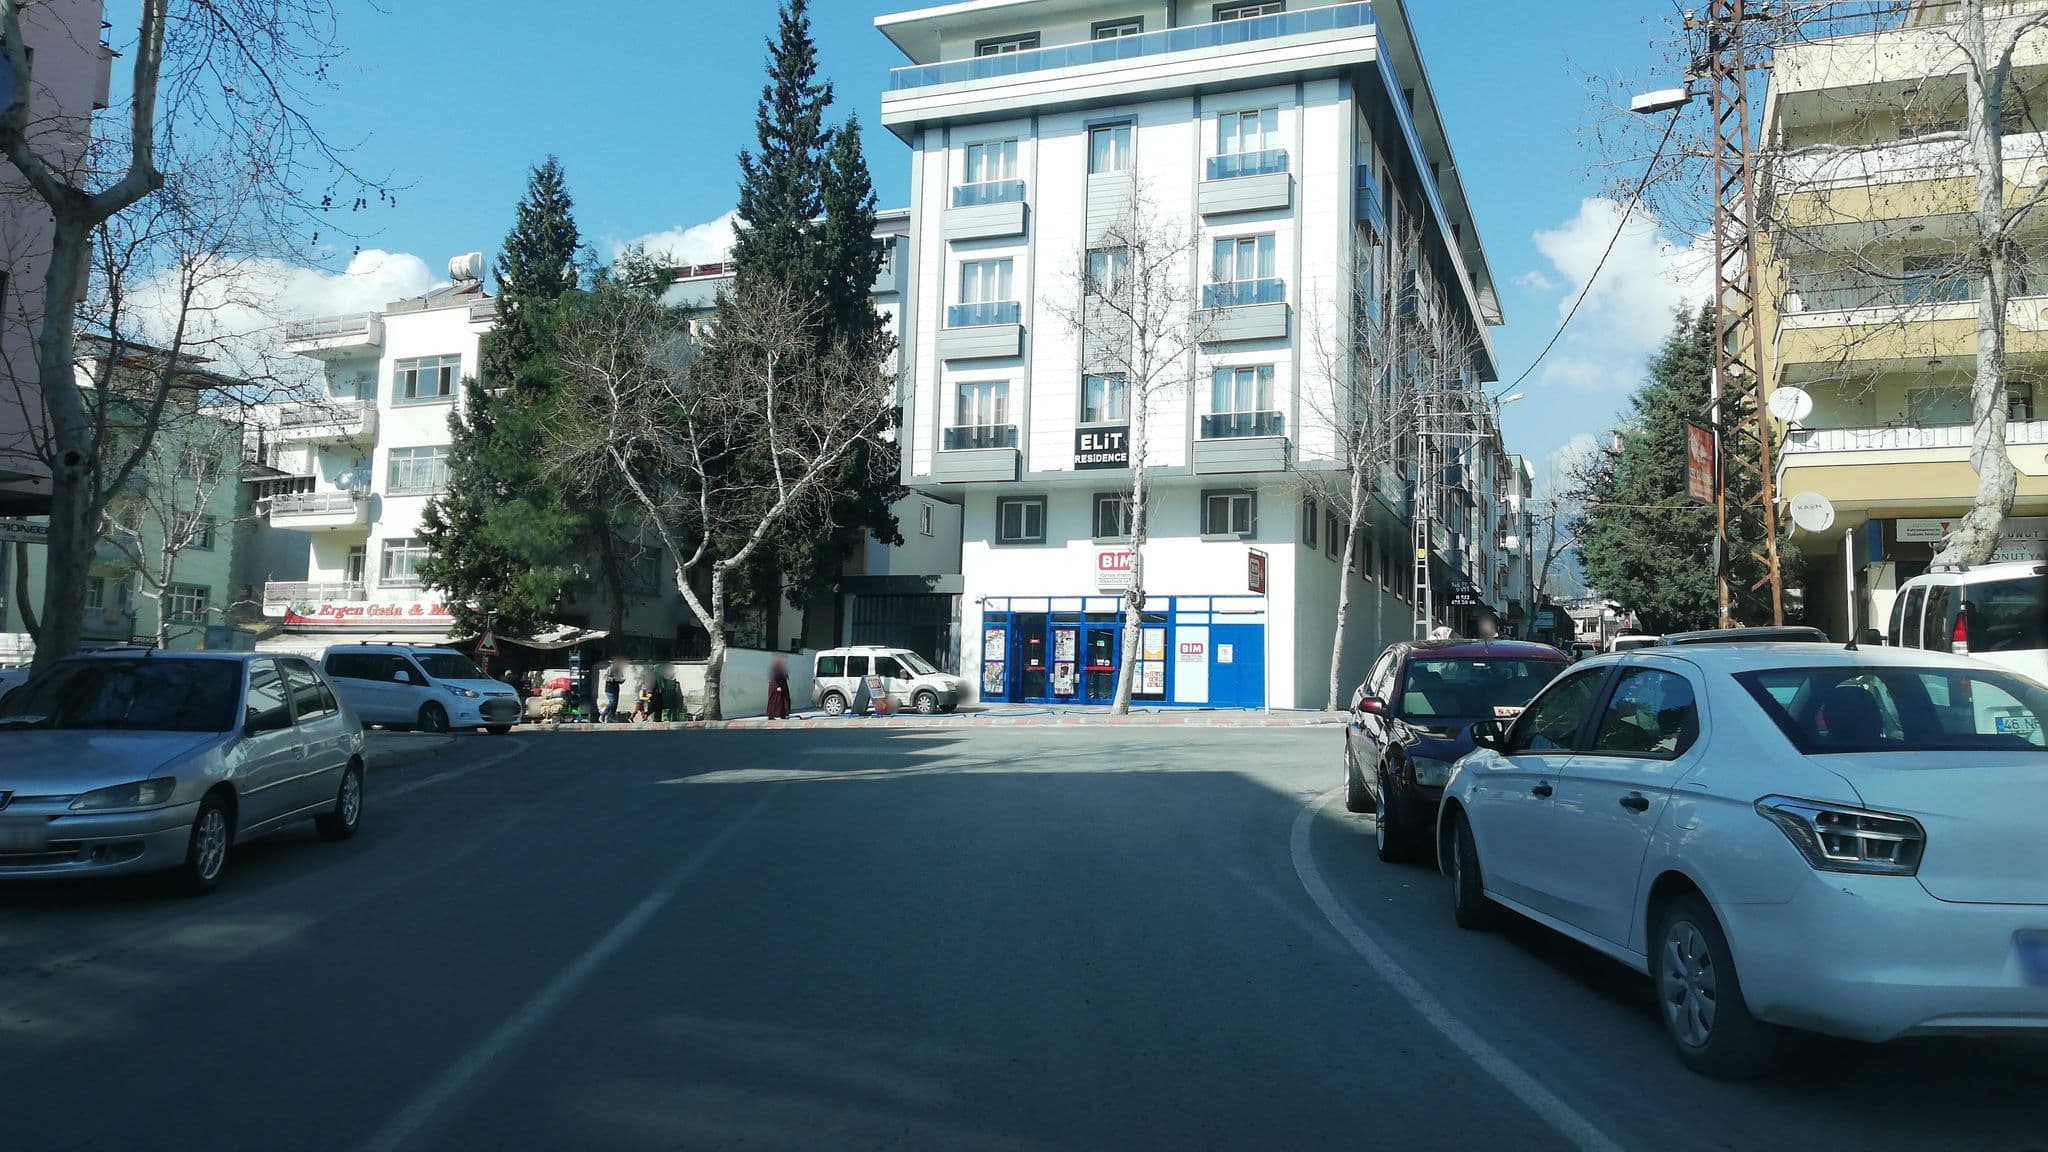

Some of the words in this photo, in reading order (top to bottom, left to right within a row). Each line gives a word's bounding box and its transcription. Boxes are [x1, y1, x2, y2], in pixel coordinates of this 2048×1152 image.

[0, 522, 48, 534] PIONEE
[1991, 552, 2026, 561] ONUT
[319, 604, 364, 618] Ergen
[408, 604, 424, 616] &
[2004, 719, 2020, 730] 46
